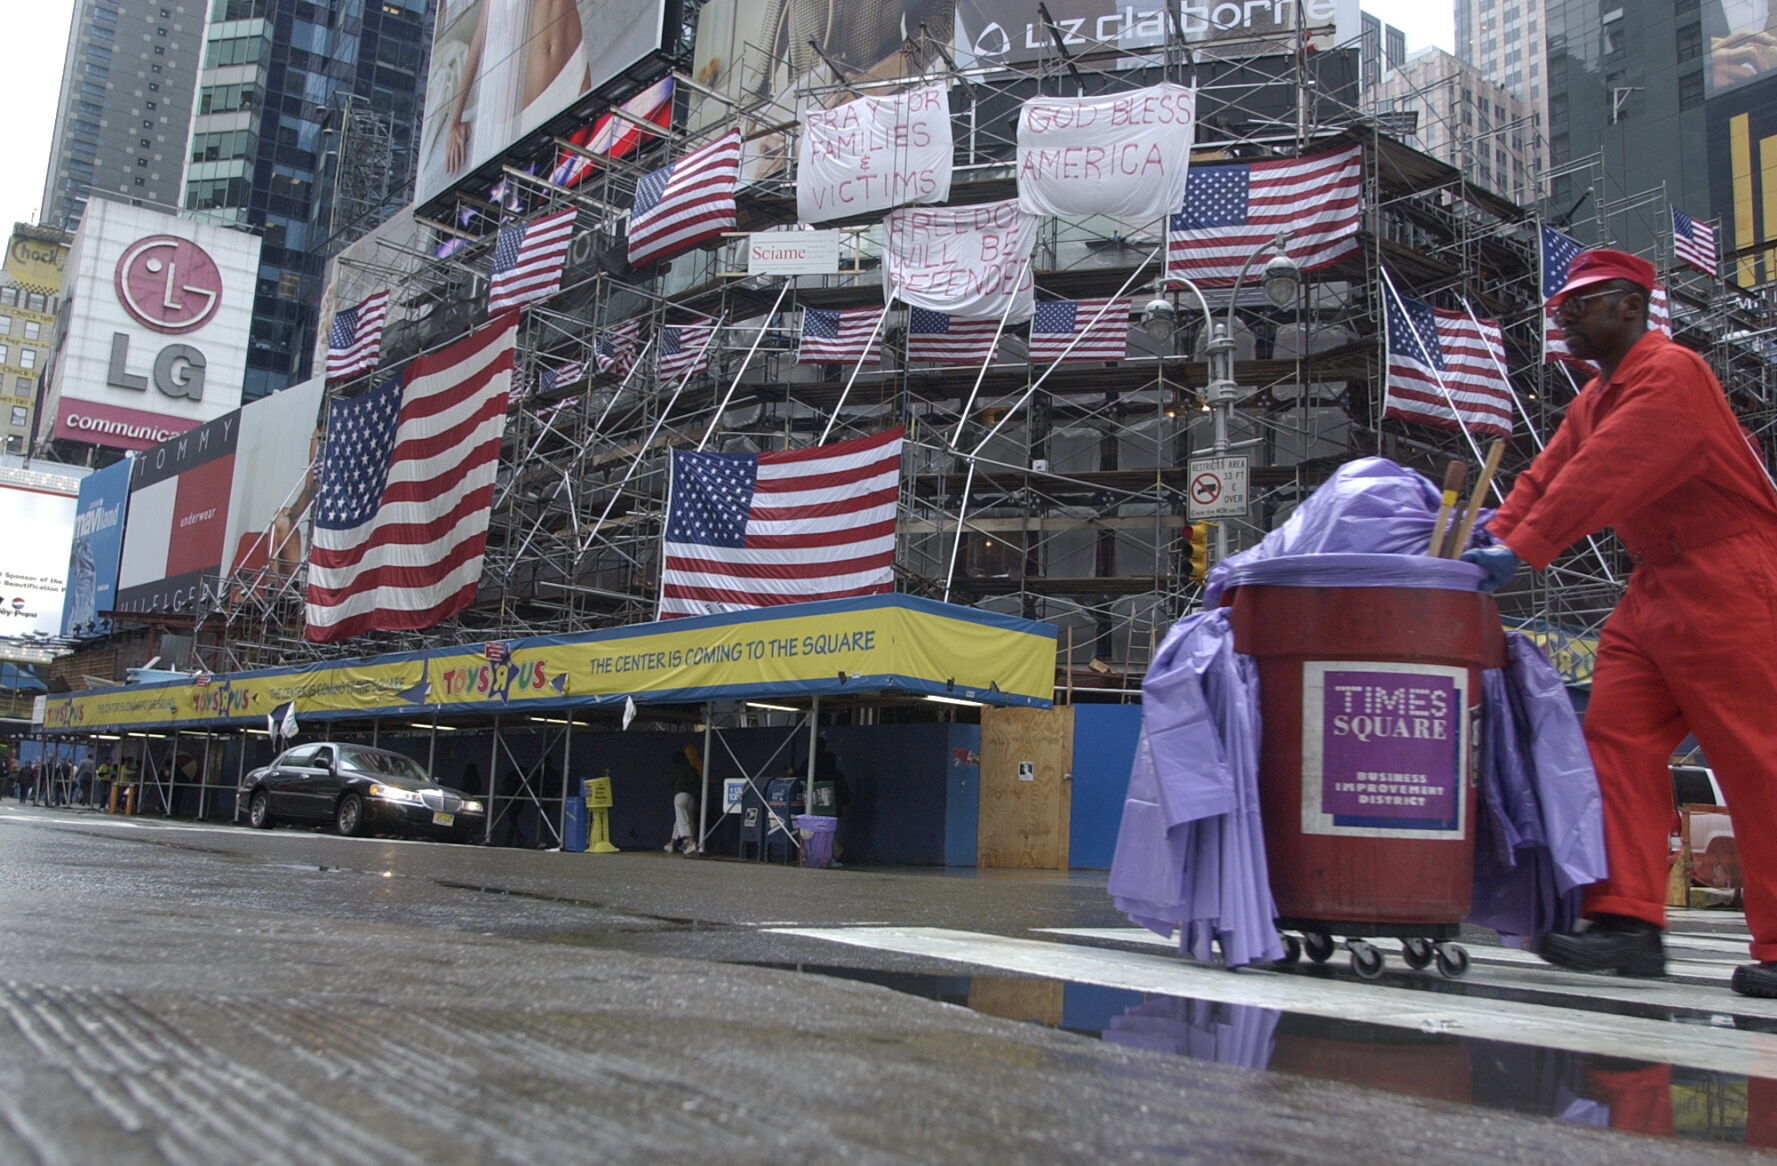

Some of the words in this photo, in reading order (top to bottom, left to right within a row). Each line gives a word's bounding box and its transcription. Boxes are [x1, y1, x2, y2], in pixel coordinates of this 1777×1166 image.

[808, 100, 880, 134] PRAY
[1028, 102, 1097, 133] GOD
[1111, 94, 1191, 126] BLESS
[812, 122, 931, 165] FAMILIES
[860, 154, 871, 171] &
[1020, 143, 1164, 181] AMERICA
[812, 170, 936, 209] VICTIMS
[752, 245, 806, 260] Sciame
[893, 242, 957, 268] WILL
[981, 229, 1019, 262] BE
[890, 258, 1032, 297] DEFENDED
[107, 331, 208, 402] LG
[66, 412, 188, 444] communica
[141, 418, 232, 477] TOMMY
[1192, 459, 1225, 472] RESTRICTED
[1228, 461, 1245, 469] AREA
[1224, 494, 1243, 503] OVER
[180, 507, 216, 528] underwear
[4, 580, 59, 592] Beautification
[5, 572, 37, 581] Sponsor
[590, 657, 612, 674] THE
[615, 651, 666, 671] CENTER
[667, 650, 682, 666] IS
[685, 642, 743, 665] COMING
[746, 640, 765, 659] TO
[768, 638, 799, 657] THE
[802, 630, 876, 655] SQUARE
[443, 666, 489, 694] TOYS
[519, 660, 546, 690] US
[1334, 685, 1447, 717] TIMES
[1333, 715, 1447, 742] SQUARE
[1335, 782, 1444, 796] IMPROVEMENT
[1356, 772, 1428, 784] BUSINESS
[1358, 795, 1426, 806] DISTRICT
